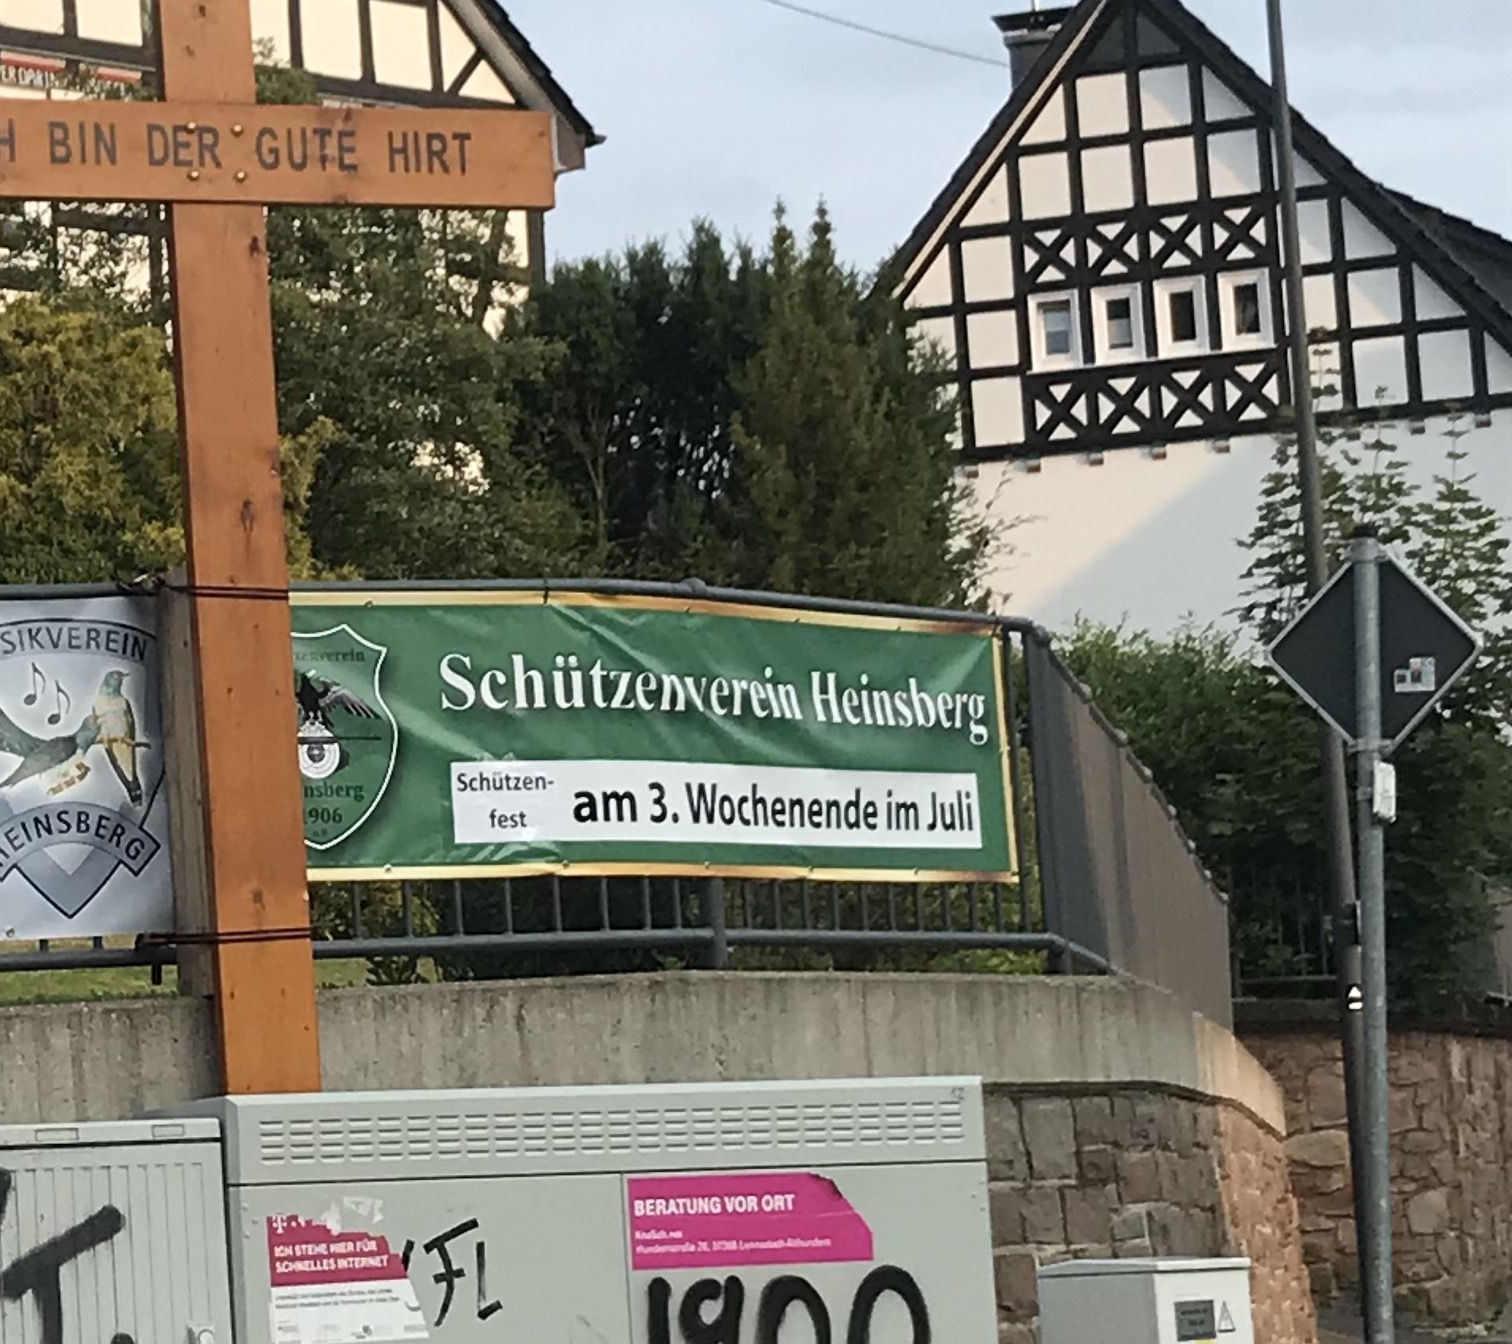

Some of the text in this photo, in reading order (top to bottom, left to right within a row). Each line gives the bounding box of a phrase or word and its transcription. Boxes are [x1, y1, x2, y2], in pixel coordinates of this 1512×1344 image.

[48, 121, 117, 165] BIN
[147, 123, 222, 169] DER
[255, 126, 359, 173] GUTE
[387, 130, 471, 175] HIRT
[439, 653, 989, 745] Schützenverein Heinsberg
[456, 769, 555, 795] Schützen-
[489, 808, 527, 830] fest
[573, 782, 974, 832] am 3. Wochenende im Juli
[634, 1193, 795, 1216] BERATUNG VOR ORT
[274, 1245, 293, 1257] ICH
[356, 1239, 378, 1252] FÜR
[275, 1255, 388, 1273] SCHNELLES INTERNET
